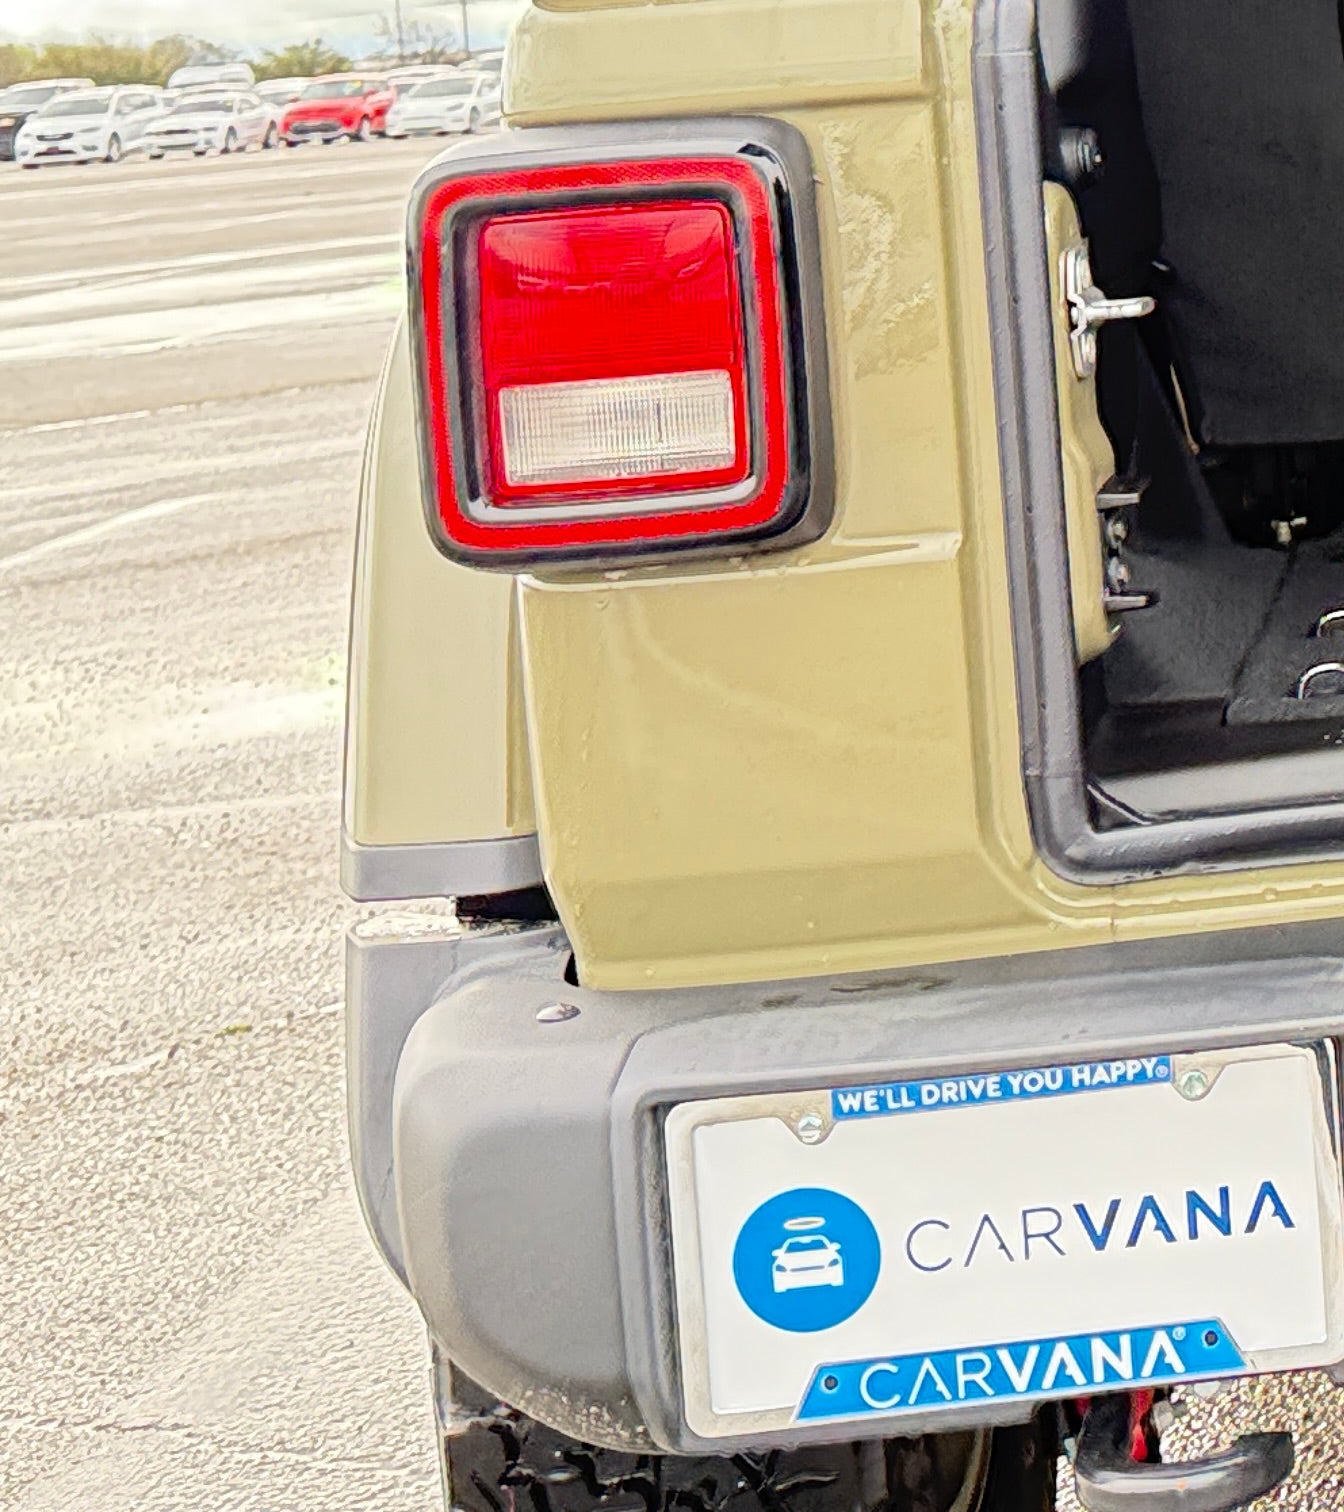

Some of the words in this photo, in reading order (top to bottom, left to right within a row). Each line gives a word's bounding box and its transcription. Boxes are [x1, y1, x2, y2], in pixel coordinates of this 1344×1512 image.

[837, 1086, 915, 1113] WE'LL
[921, 1076, 1002, 1105] DRIVE
[1008, 1068, 1064, 1094] YOU
[906, 1180, 1297, 1272] CARVANA
[859, 1329, 1186, 1409] CARVANA
